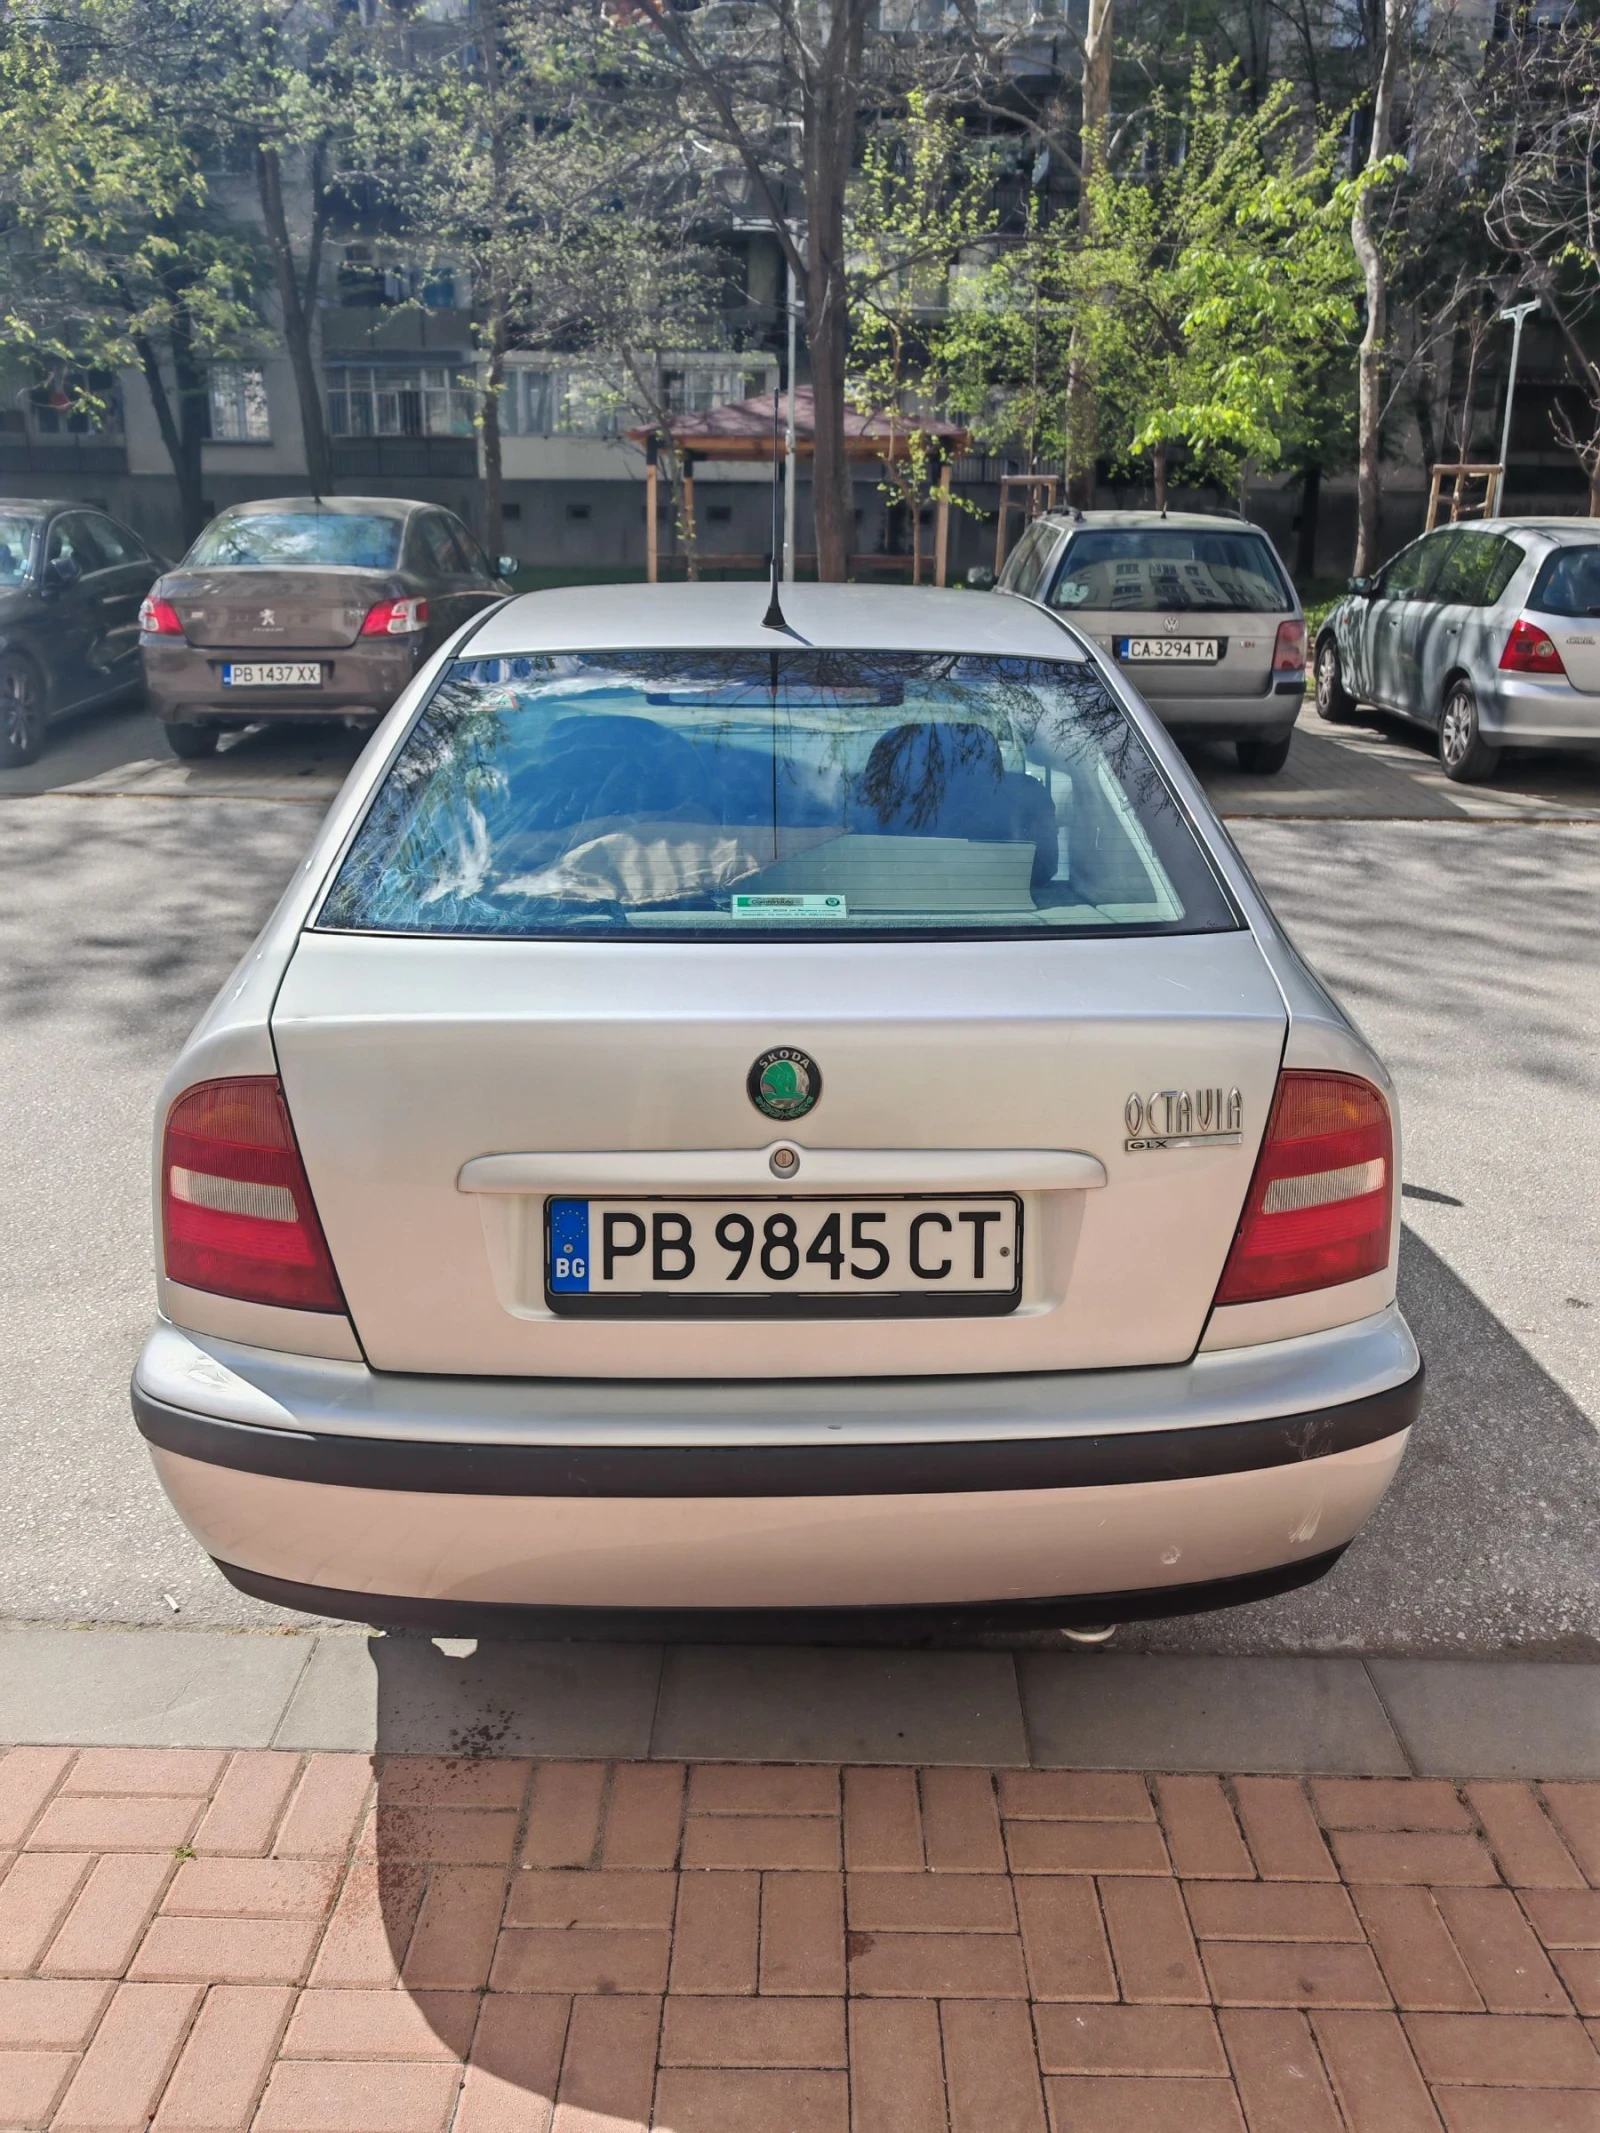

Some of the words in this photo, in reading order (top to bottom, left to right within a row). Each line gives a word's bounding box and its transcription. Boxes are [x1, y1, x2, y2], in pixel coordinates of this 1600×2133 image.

[1131, 641, 1151, 657] CA
[1154, 641, 1191, 657] 3294
[1195, 642, 1214, 657] TA
[233, 667, 254, 682] PB
[258, 666, 293, 682] 1437
[297, 666, 316, 681] XX
[1125, 1085, 1243, 1137] OCTAVIA
[1130, 1140, 1168, 1149] GLX
[602, 1212, 696, 1280] PB
[715, 1212, 890, 1280] 9845
[909, 1211, 1001, 1279] CT
[556, 1257, 585, 1278] BG
